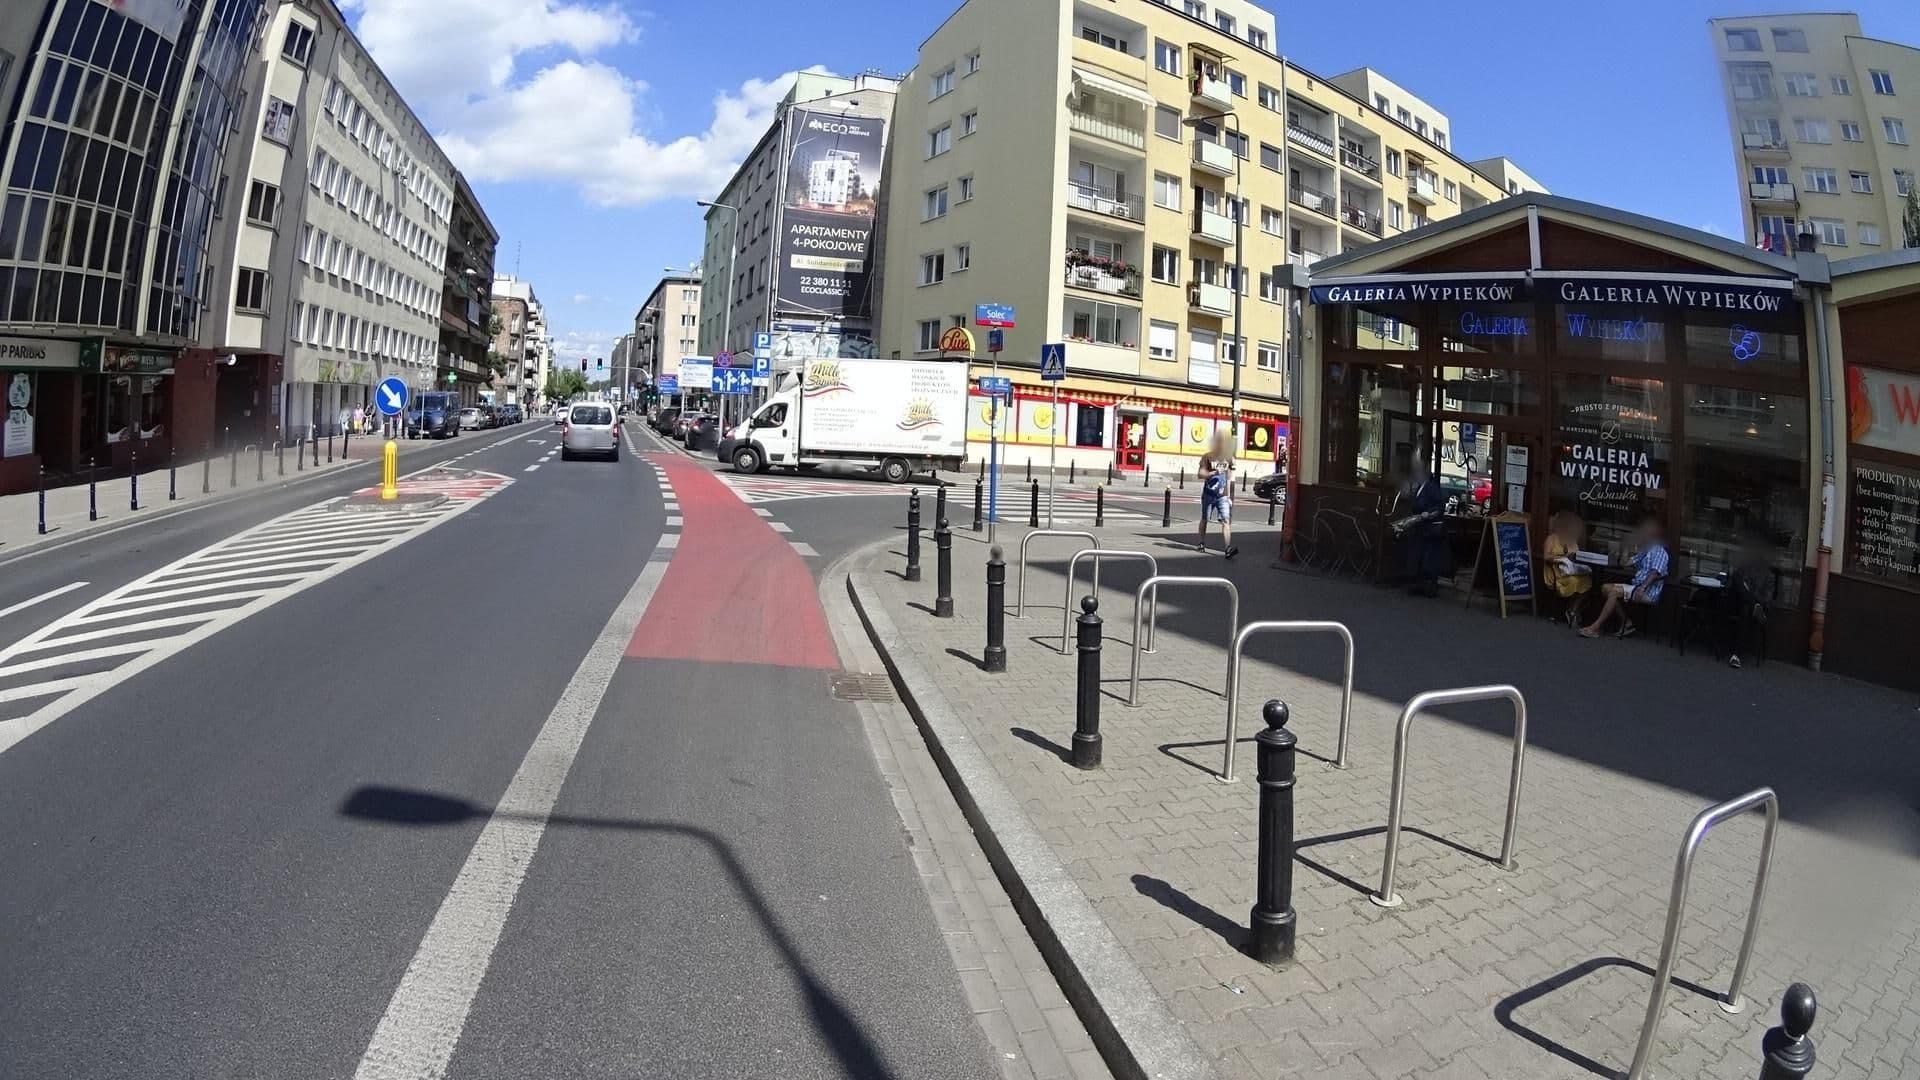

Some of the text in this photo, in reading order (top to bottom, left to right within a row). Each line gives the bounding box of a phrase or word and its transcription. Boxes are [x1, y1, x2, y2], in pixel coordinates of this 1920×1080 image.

[791, 224, 869, 240] APARTAMENTY
[793, 238, 865, 253] 4-POKOJOWE
[800, 276, 811, 285] 22
[812, 277, 829, 286] 380
[830, 279, 840, 287] 11
[1328, 283, 1515, 301] GALERIA WYPIEKÓW
[1561, 282, 1782, 312] GALERIA WYPIEKÓW
[986, 309, 1006, 320] Solec
[1460, 312, 1529, 336] GALERIA
[1575, 403, 1603, 413] PROSTO
[1573, 444, 1649, 468] GALERIA
[1561, 461, 1660, 490] WYPIEKÓW
[1856, 467, 1906, 487] PRODUKTY
[1863, 506, 1890, 521] wyroby
[1862, 516, 1880, 529] drób
[1886, 522, 1907, 535] mięso
[1861, 542, 1877, 555] sery
[1889, 557, 1917, 575] kapusta
